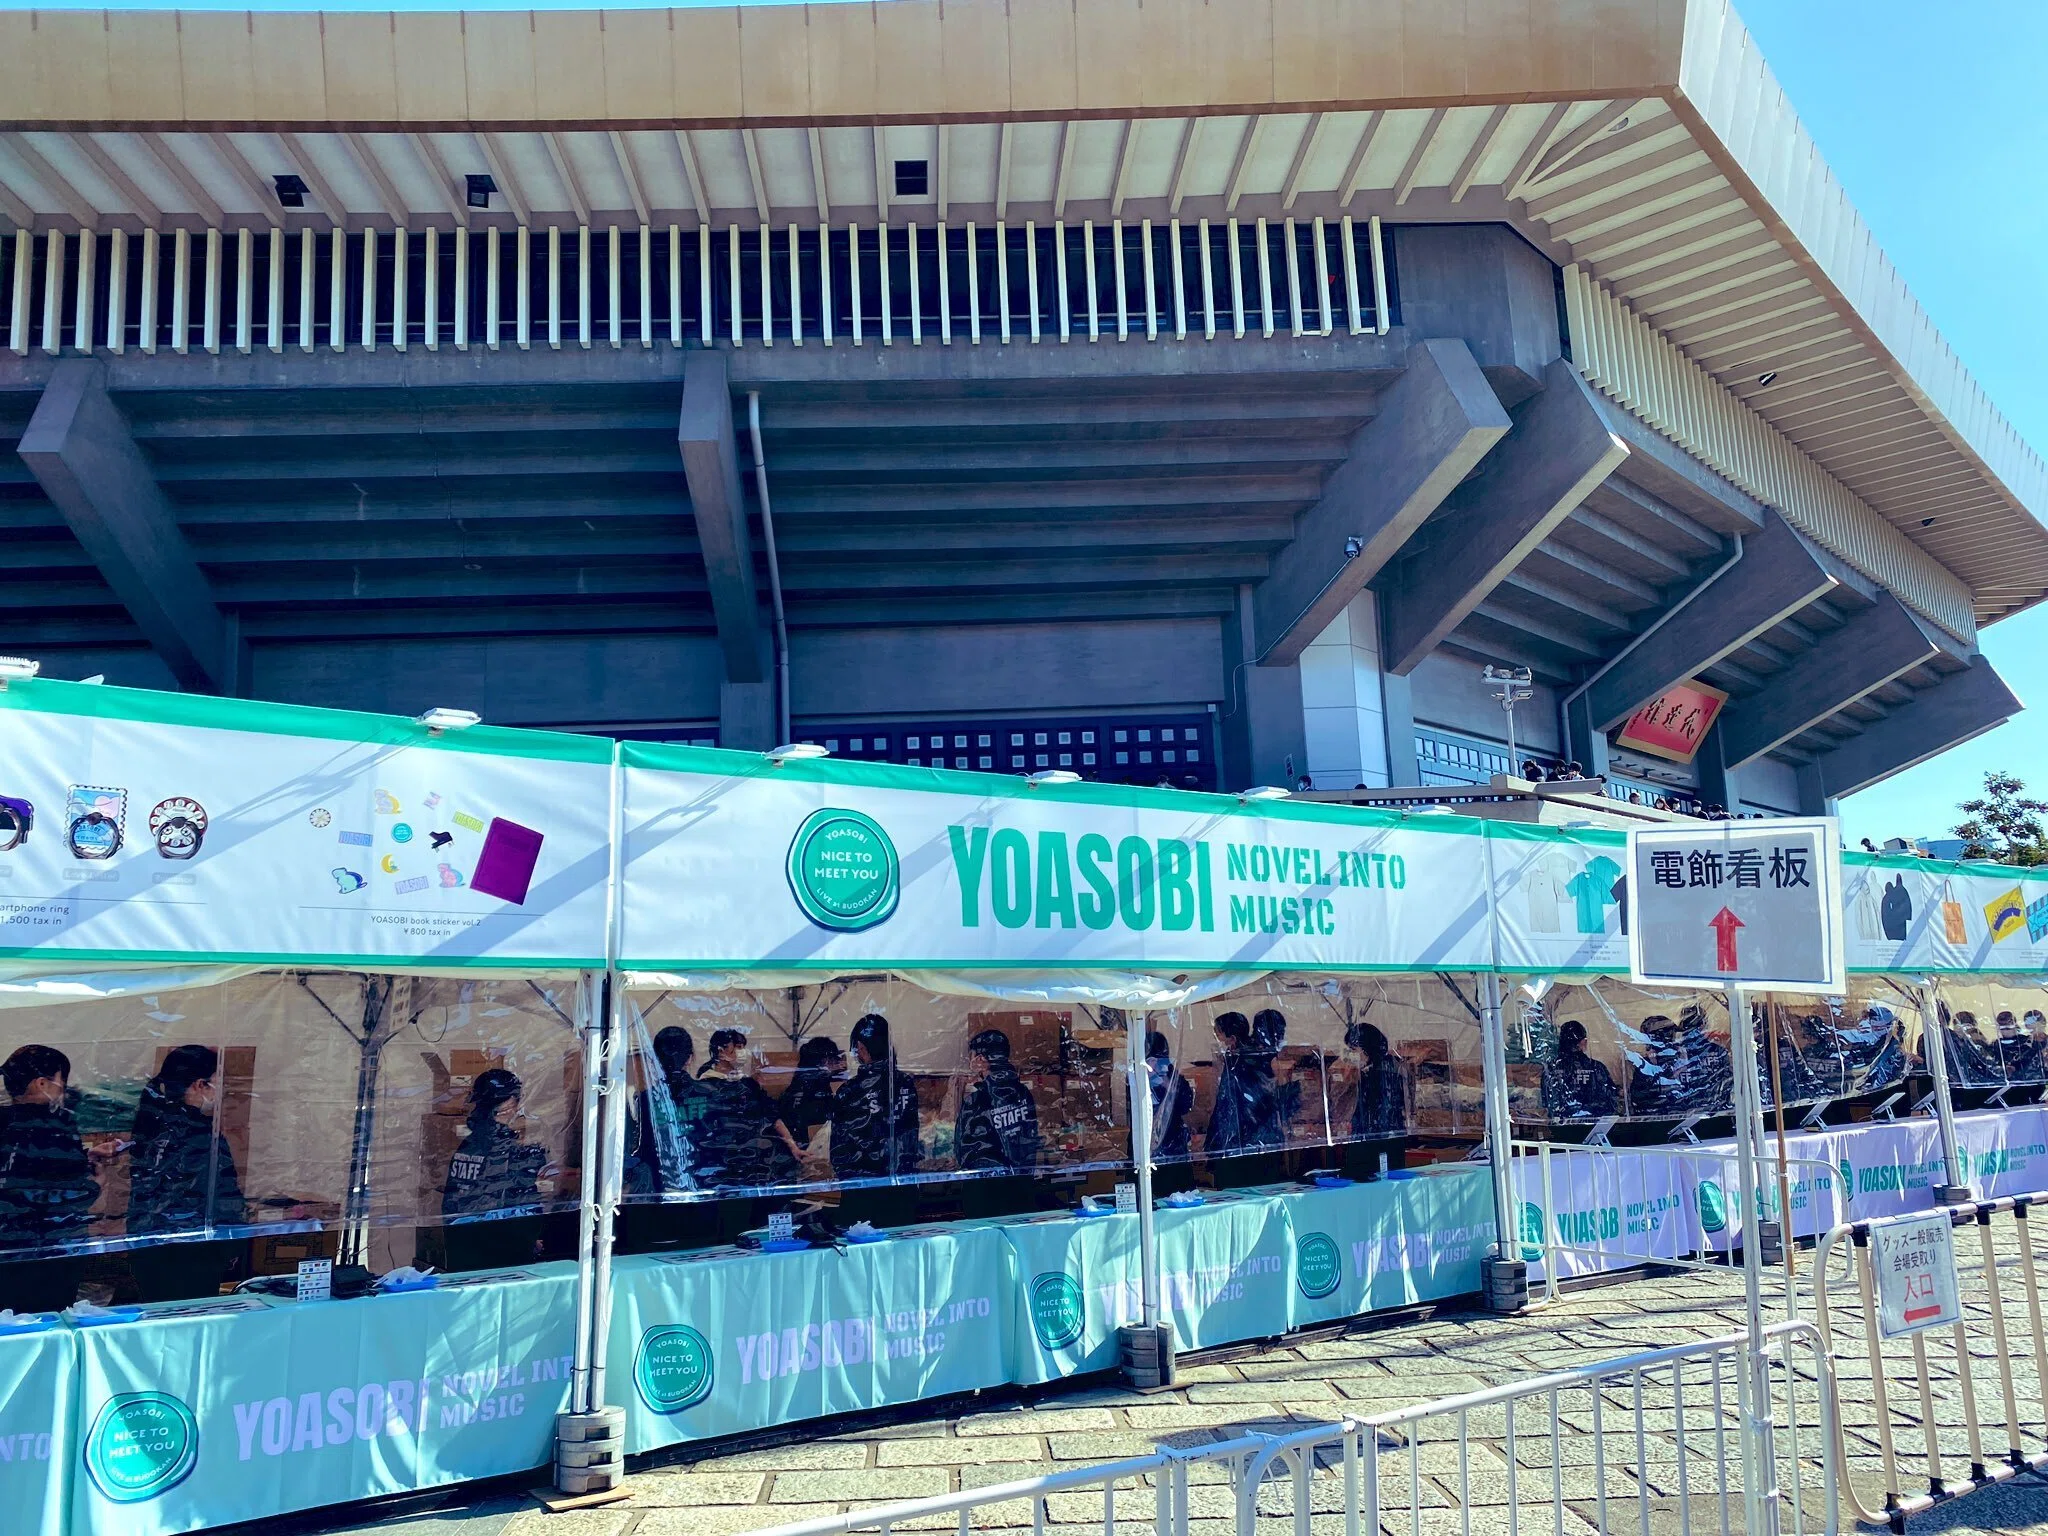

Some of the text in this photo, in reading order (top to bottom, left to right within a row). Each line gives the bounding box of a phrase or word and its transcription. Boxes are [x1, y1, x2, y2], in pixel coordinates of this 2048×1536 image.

[826, 829, 868, 844] YOASOBI
[822, 850, 872, 862] NICE TO
[814, 868, 878, 880] MEET YOU
[1227, 844, 1406, 890] NOVEL INTO
[1650, 848, 1810, 888] 電飾看板
[948, 825, 1214, 932] YOASOBI
[816, 888, 832, 904] LIVE
[842, 888, 878, 910] BUDOKAN
[50, 904, 70, 916] ring
[1230, 894, 1335, 936] MUSIC
[52, 917, 62, 925] in
[371, 916, 408, 924] YOASOBI
[410, 916, 430, 925] book
[994, 1106, 1028, 1129] STAFF
[451, 1161, 480, 1180] STAFF
[1928, 1160, 1944, 1172] INT
[1790, 1196, 1808, 1210] USIC
[1557, 1207, 1620, 1244] YOASOB
[1436, 1227, 1472, 1245] NOVEL
[1883, 1226, 1944, 1252] グッズ一般販売
[1438, 1246, 1470, 1264] MUSIC
[1894, 1248, 1936, 1272] 会場受取り
[1246, 1256, 1281, 1276] INTO
[1904, 1274, 1934, 1302] 入口
[1038, 1308, 1074, 1318] MEET YOU
[656, 1339, 690, 1348] YOASOBI
[736, 1298, 990, 1384] YOASOBI NOVEL INTO
[884, 1332, 946, 1360] MUSIC
[680, 1354, 693, 1362] TO
[650, 1366, 698, 1376] MEET YOU
[232, 1356, 573, 1462] YOASOBI NOVEL INT
[440, 1393, 525, 1429] MUSIC
[114, 1427, 169, 1442] NICE TO
[109, 1440, 174, 1458] MEET YOU
